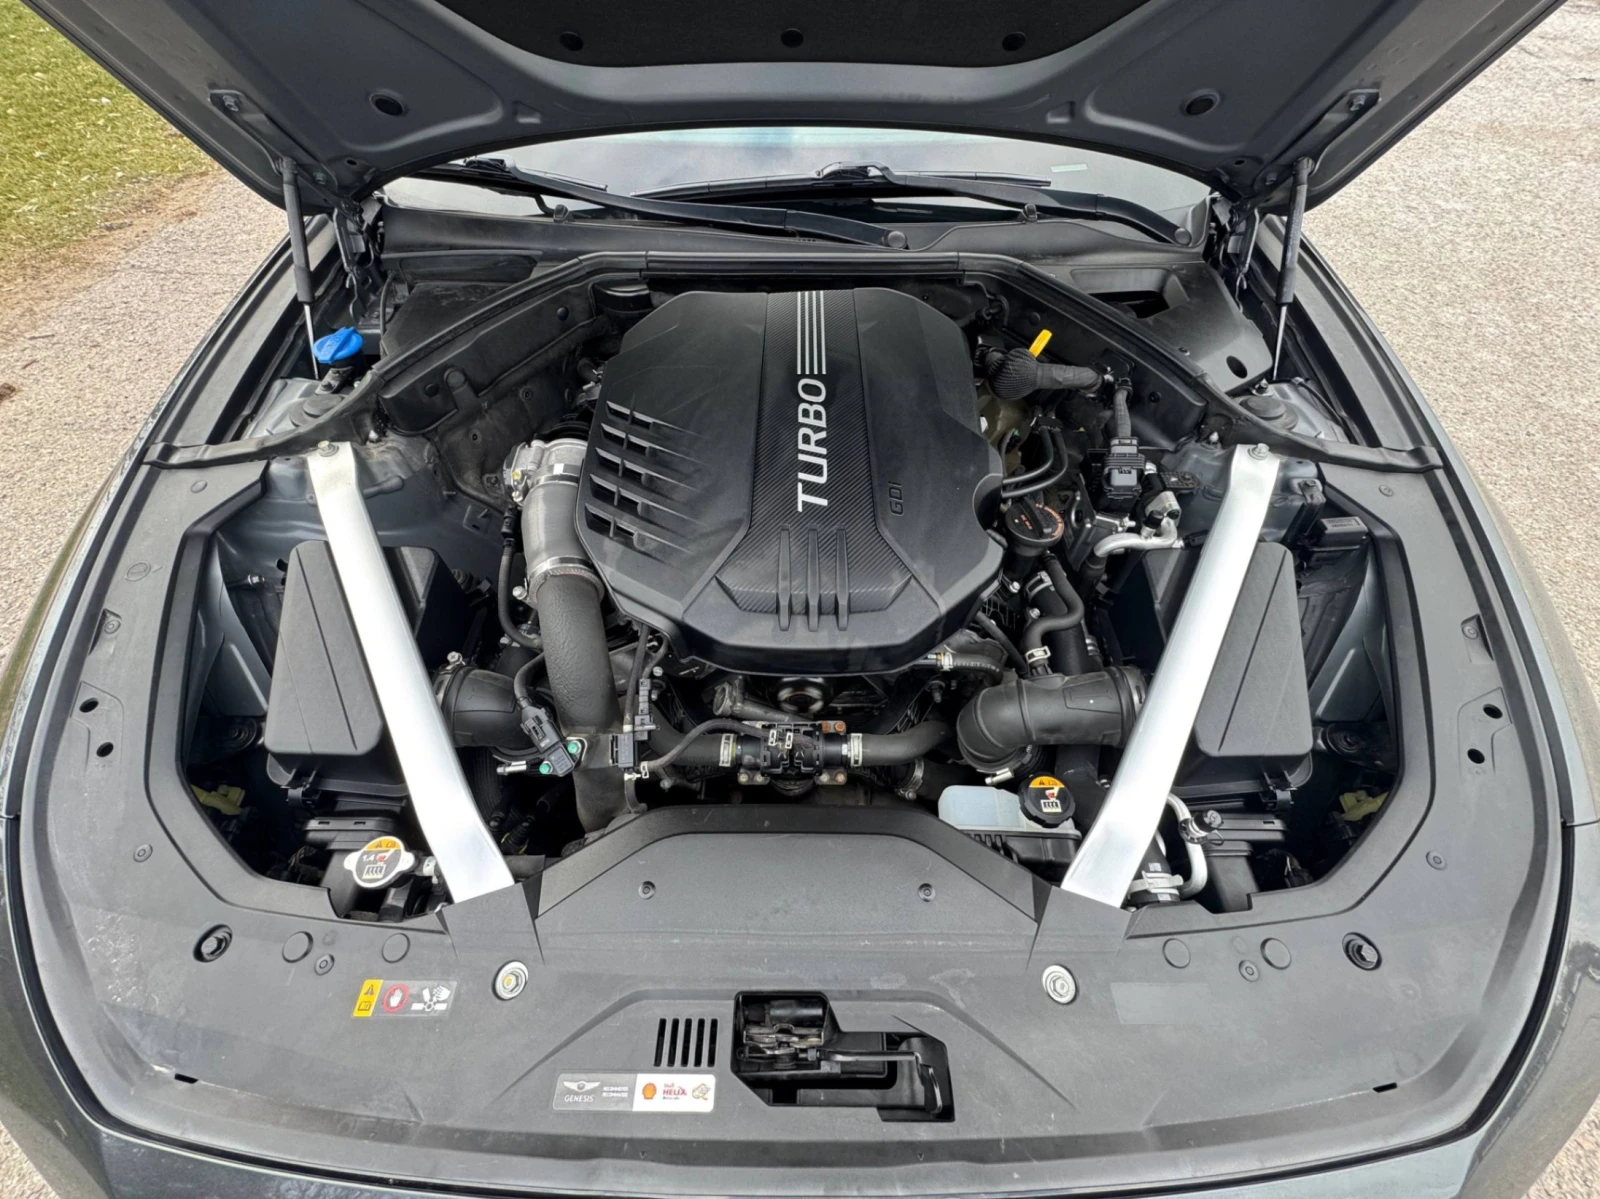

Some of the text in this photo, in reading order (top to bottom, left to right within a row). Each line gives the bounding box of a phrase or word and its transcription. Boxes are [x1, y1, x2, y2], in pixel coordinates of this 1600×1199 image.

[797, 378, 828, 512] TURBO
[663, 1088, 686, 1096] HELIX
[564, 1094, 594, 1102] GENESIS
